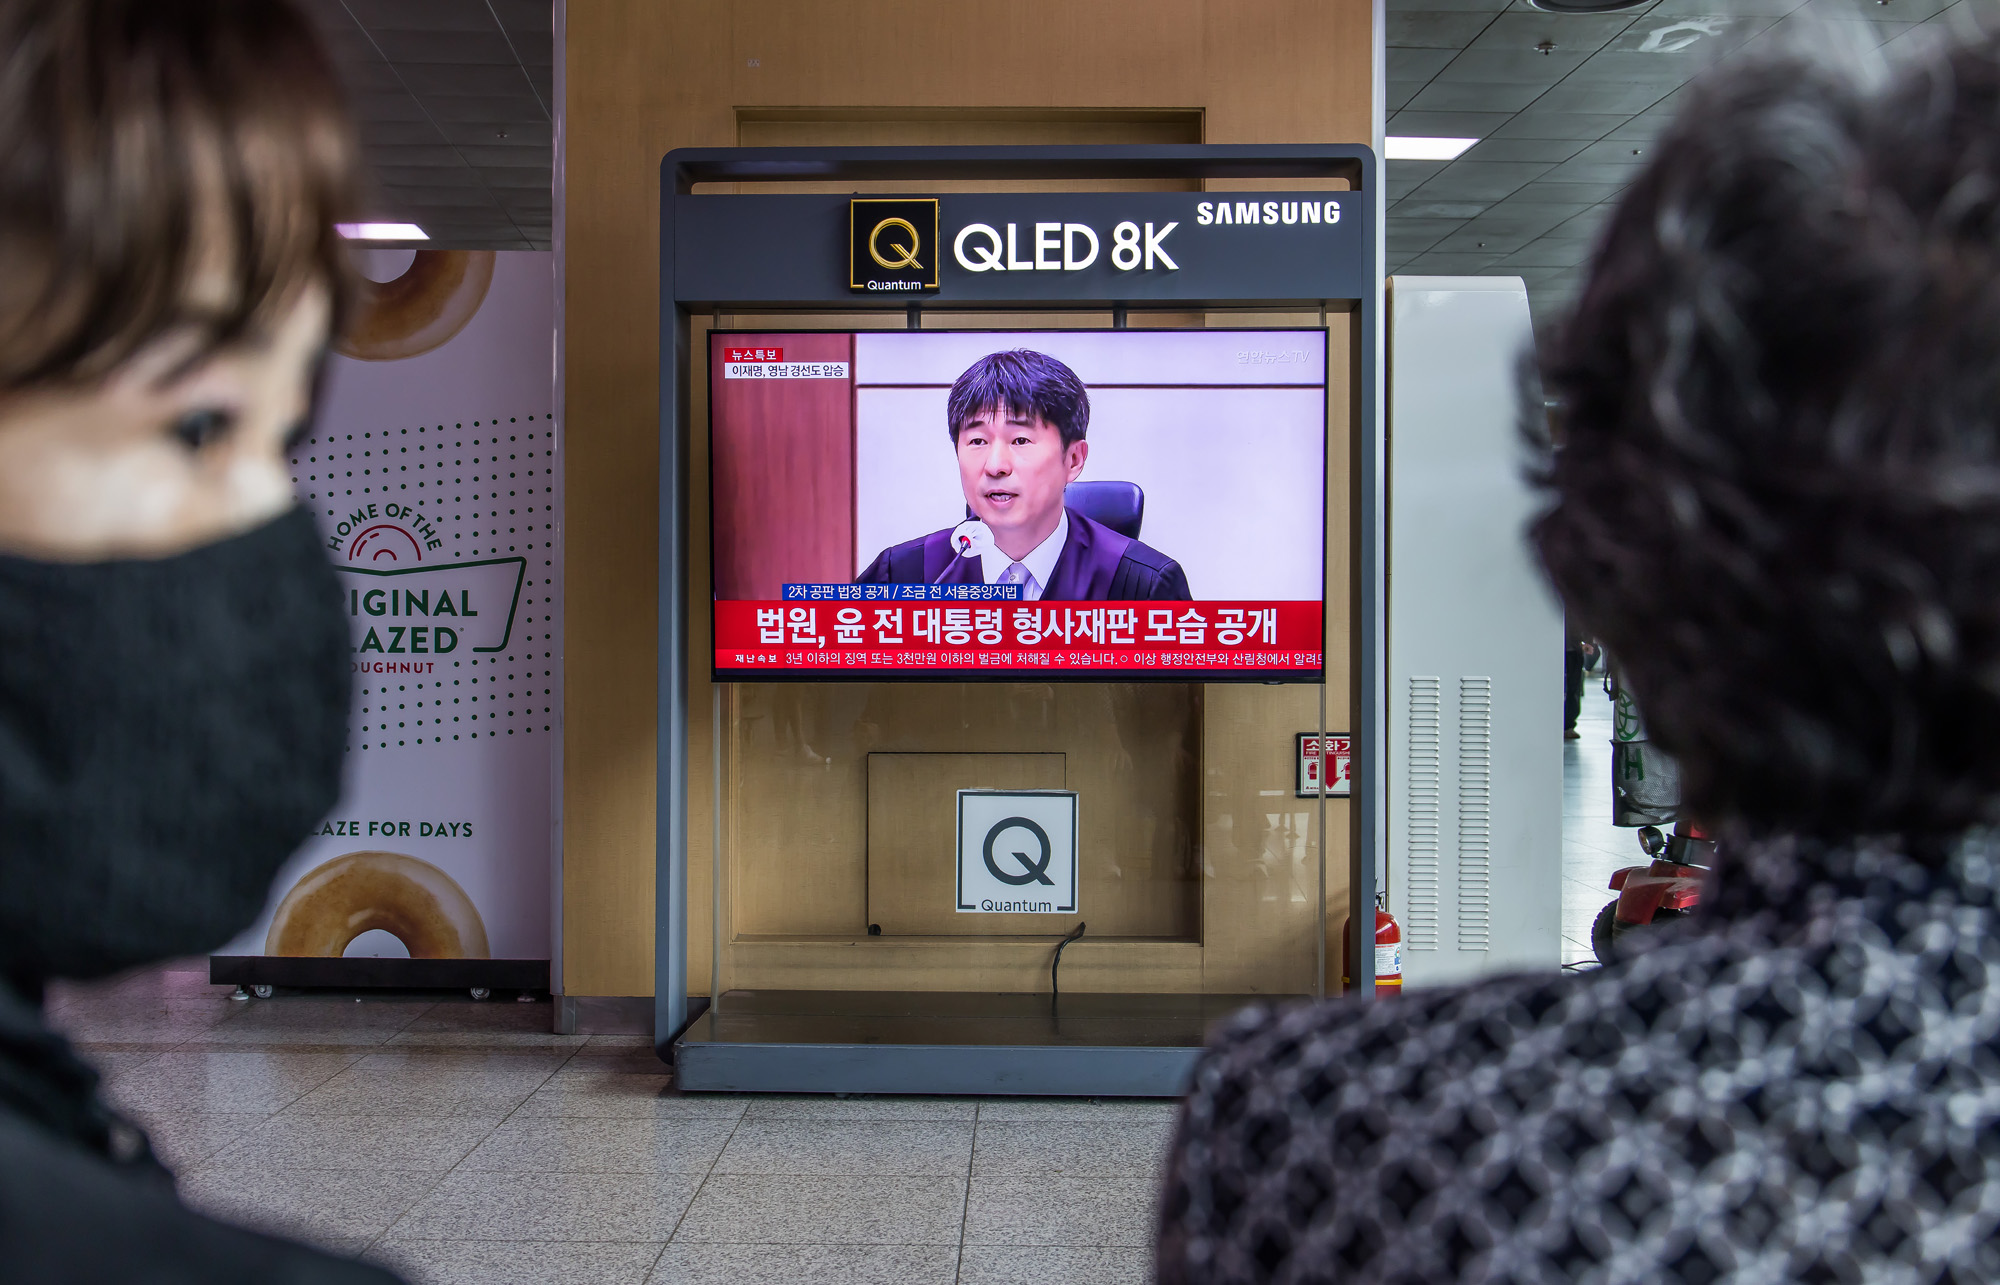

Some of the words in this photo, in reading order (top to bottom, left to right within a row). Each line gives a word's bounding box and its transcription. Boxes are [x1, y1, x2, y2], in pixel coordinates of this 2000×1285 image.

[1197, 201, 1341, 225] SAMSUNG
[868, 217, 924, 270] Q
[953, 222, 1100, 272] QLED
[1111, 221, 1179, 271] 8K
[867, 280, 922, 292] Quantum
[732, 349, 777, 361] 뉴스특보
[732, 365, 766, 378] 이재명,
[768, 365, 788, 377] 영남
[790, 365, 821, 377] 경선도
[822, 365, 844, 377] 압승
[327, 503, 379, 551] HOME
[385, 503, 413, 520] OF
[412, 513, 443, 551] THE
[788, 586, 807, 599] 2차
[810, 586, 835, 599] 공판
[838, 586, 862, 599] 법정
[865, 586, 889, 599] 공개
[902, 586, 926, 599] 조금
[929, 586, 942, 599] 전
[945, 586, 1017, 599] 서울중앙지법
[351, 589, 478, 617] IGINAL
[757, 607, 826, 649] 법원,
[833, 608, 866, 644] 윤
[872, 608, 903, 644] 전
[913, 608, 1003, 645] 대통령
[1012, 608, 1139, 645] 형사재판
[1144, 608, 1208, 645] 모습
[1214, 608, 1278, 645] 공개
[351, 626, 459, 654] AZED
[735, 653, 777, 663] 재난속보
[785, 652, 803, 665] 3년
[807, 652, 841, 665] 이하의
[844, 652, 867, 665] 징역
[871, 652, 893, 665] 또는
[897, 652, 937, 665] 3천만원
[940, 652, 975, 665] 이하의
[978, 652, 1012, 666] 벌금에
[1016, 652, 1050, 665] 처해질
[1054, 652, 1066, 665] 수
[1133, 653, 1156, 666] 이상
[1160, 653, 1229, 666] 행정안전부와
[1232, 653, 1290, 666] 산림청에서
[351, 661, 434, 674] OUGHNUT
[312, 821, 360, 836] AZE
[368, 821, 411, 837] FOR
[419, 822, 473, 838] DAYS
[982, 816, 1056, 886] Q
[981, 899, 1052, 912] Quantum
